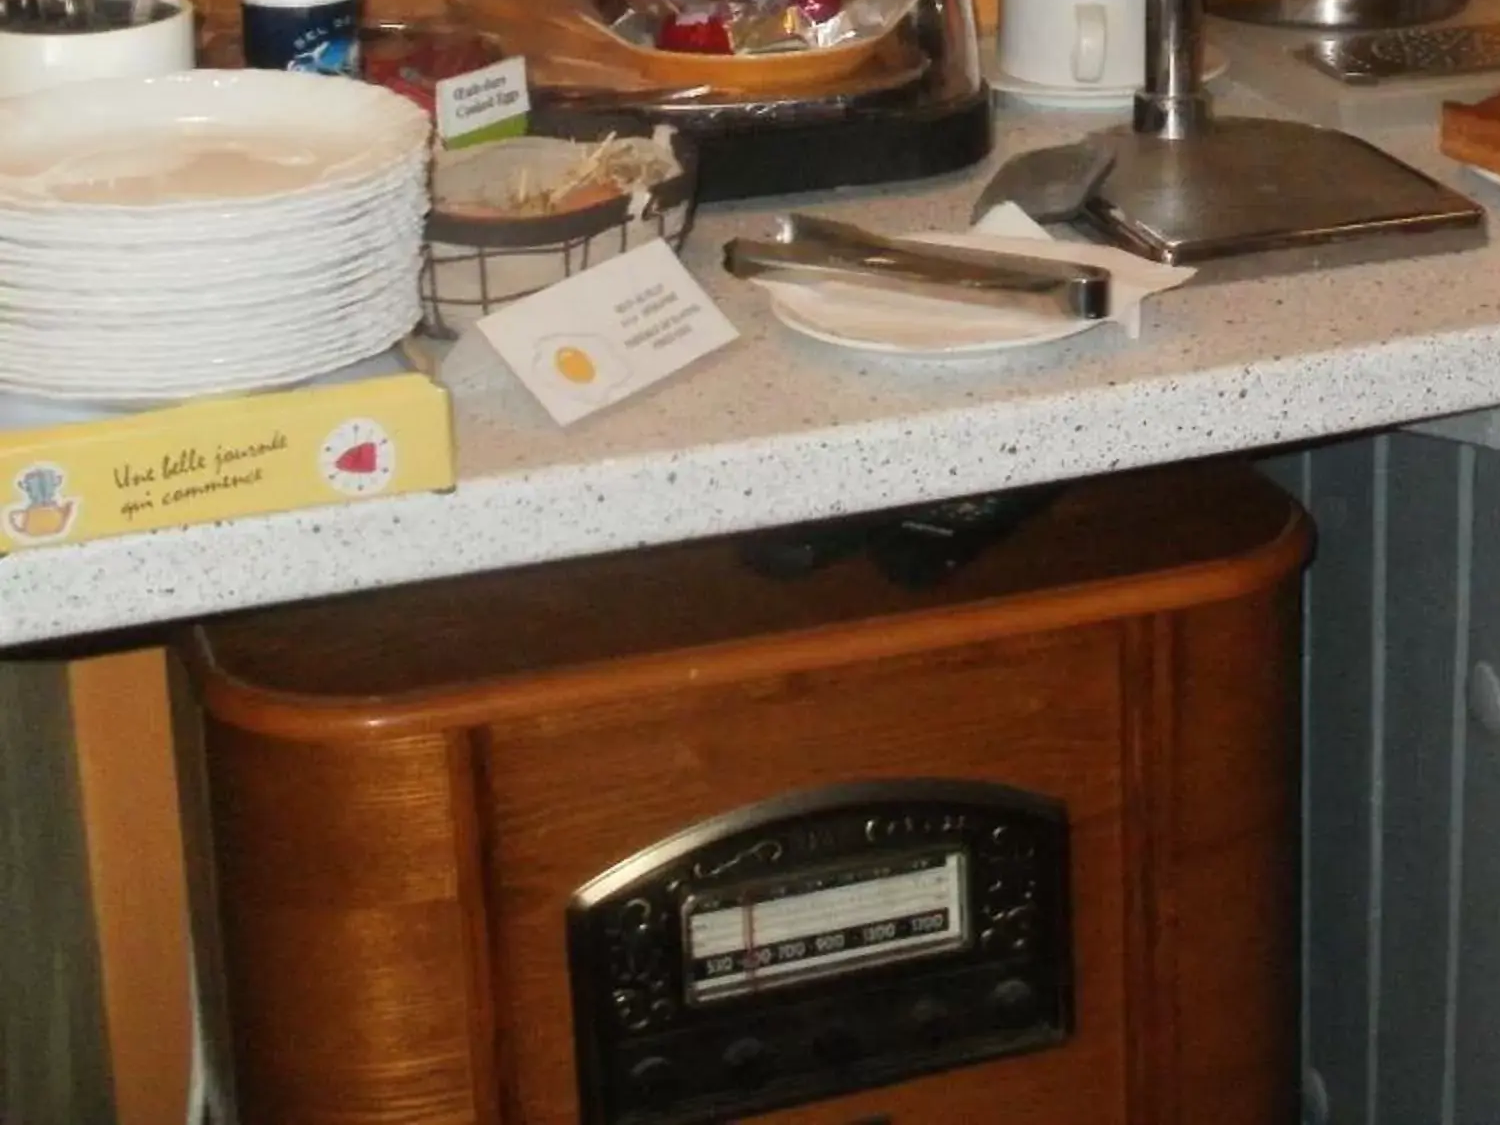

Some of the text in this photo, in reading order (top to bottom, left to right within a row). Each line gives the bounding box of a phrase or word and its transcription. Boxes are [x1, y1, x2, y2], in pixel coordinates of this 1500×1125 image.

[113, 463, 156, 489] Une
[162, 448, 206, 479] belle
[121, 468, 262, 521] qui commence
[777, 942, 806, 961] 700
[814, 934, 845, 952] 900
